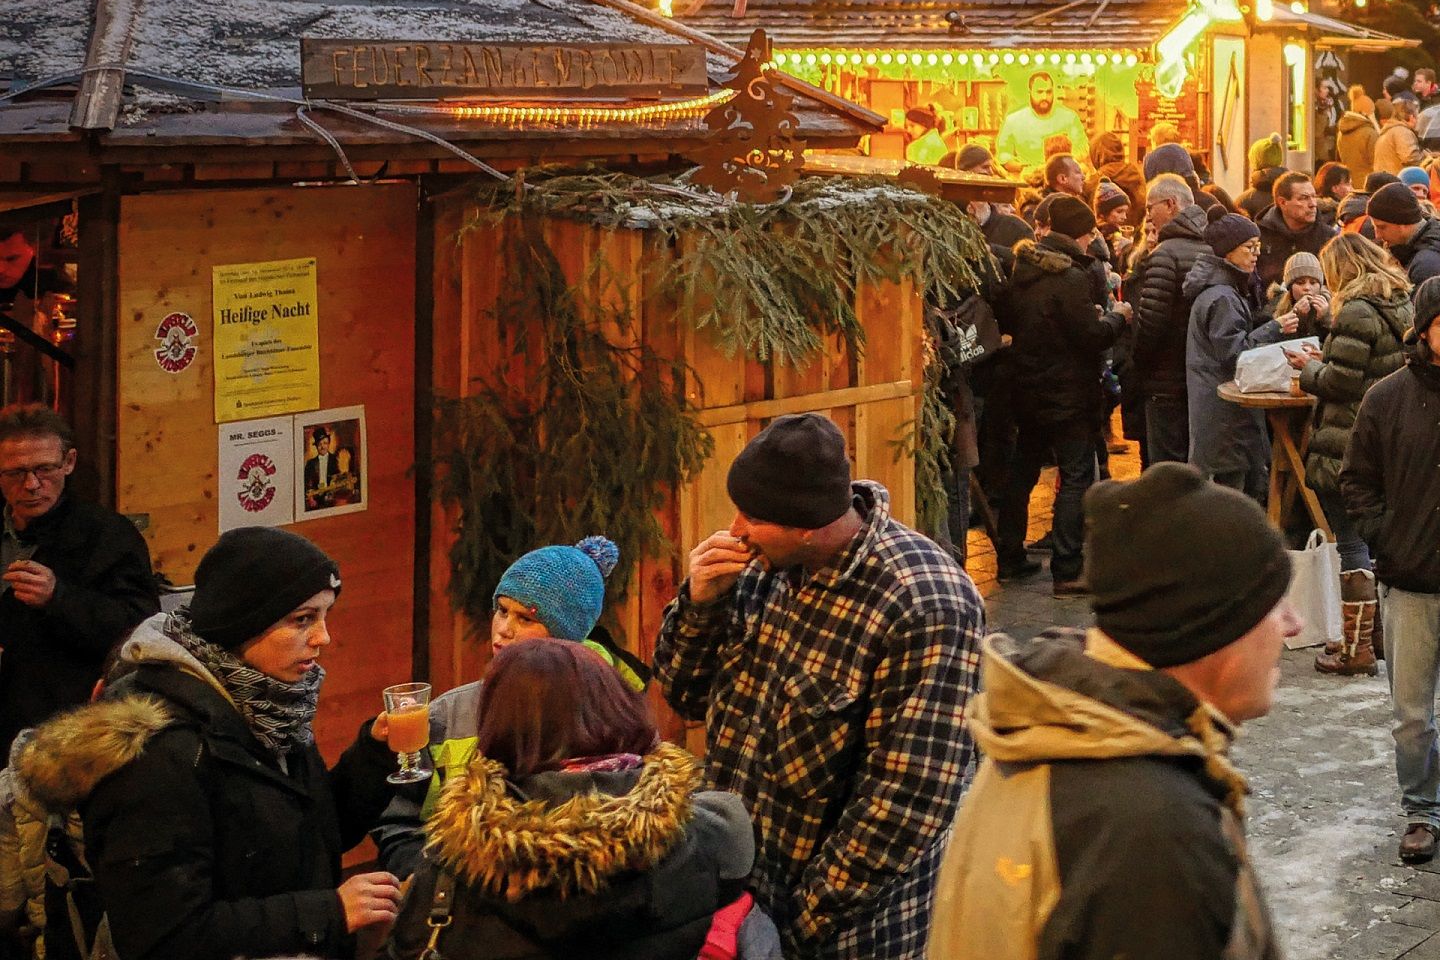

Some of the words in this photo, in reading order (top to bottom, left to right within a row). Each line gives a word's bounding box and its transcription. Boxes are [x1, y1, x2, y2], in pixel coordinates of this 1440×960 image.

[332, 45, 684, 89] FEUERZANGENBOWLE
[220, 305, 268, 326] Heilige
[272, 301, 310, 320] Nacht
[229, 432, 245, 441] MR.
[247, 428, 276, 439] SEGGS
